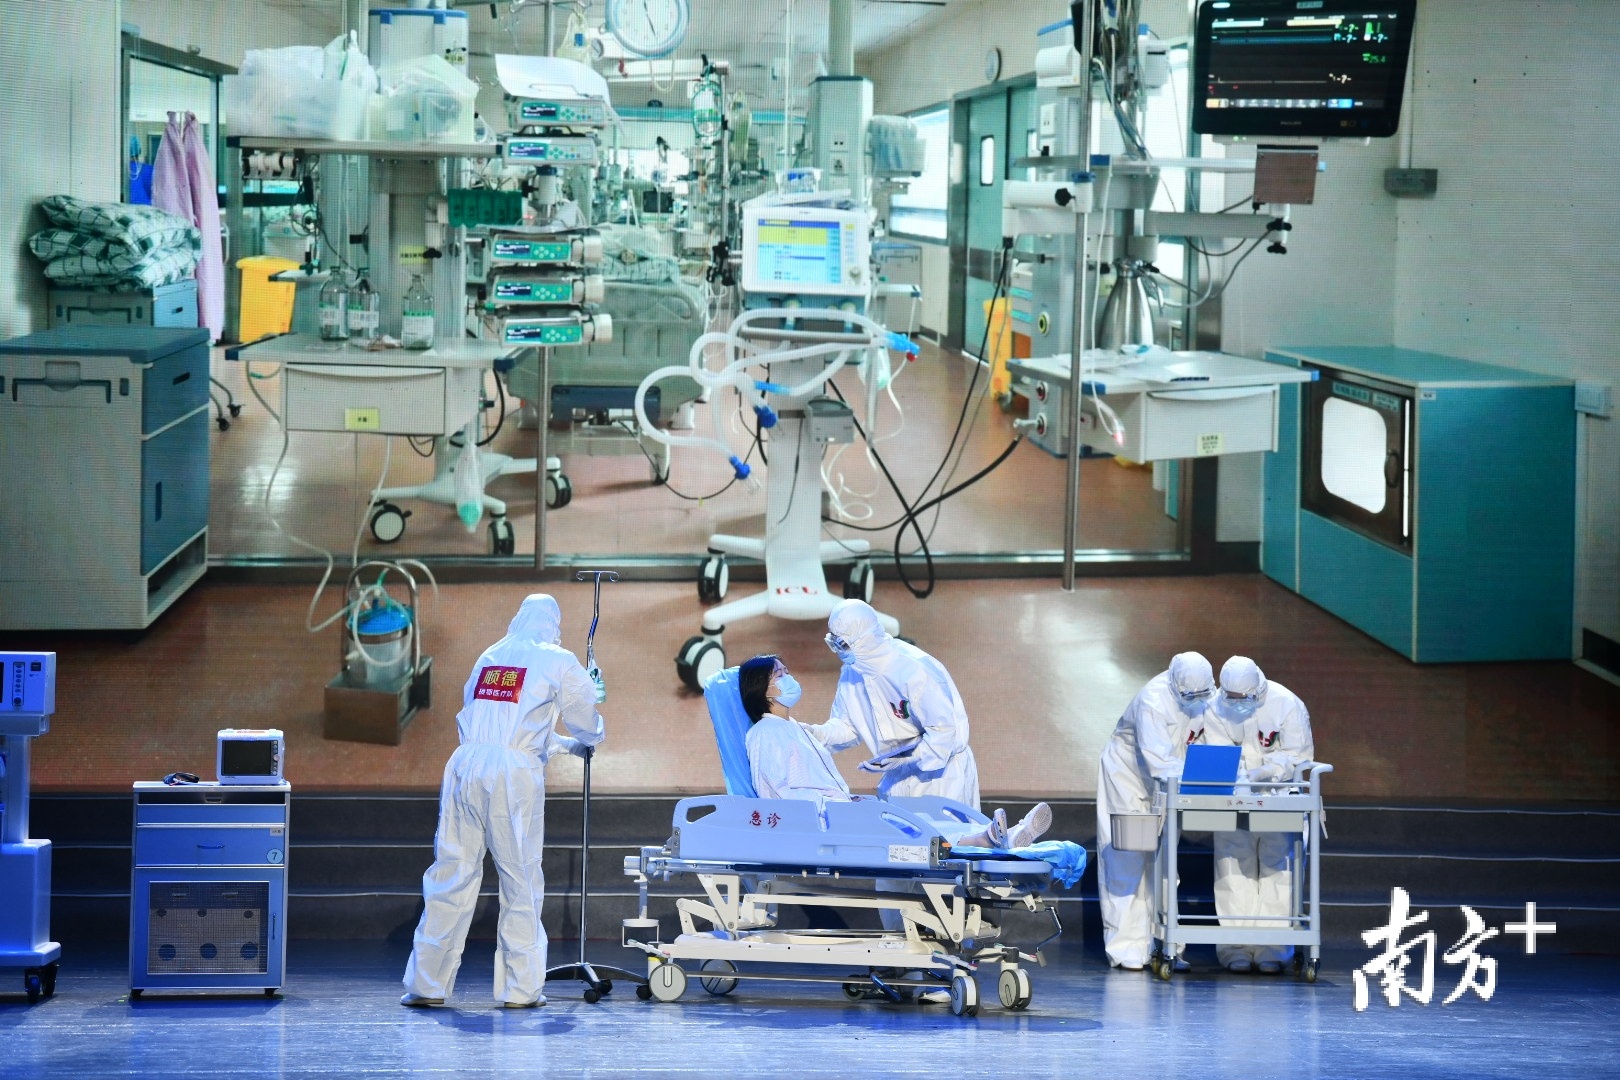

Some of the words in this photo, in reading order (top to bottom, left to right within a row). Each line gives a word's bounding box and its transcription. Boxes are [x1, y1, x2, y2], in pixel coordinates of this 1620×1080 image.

[481, 669, 519, 687] 顺德
[749, 810, 781, 828] 急诊
[271, 851, 278, 861] 7
